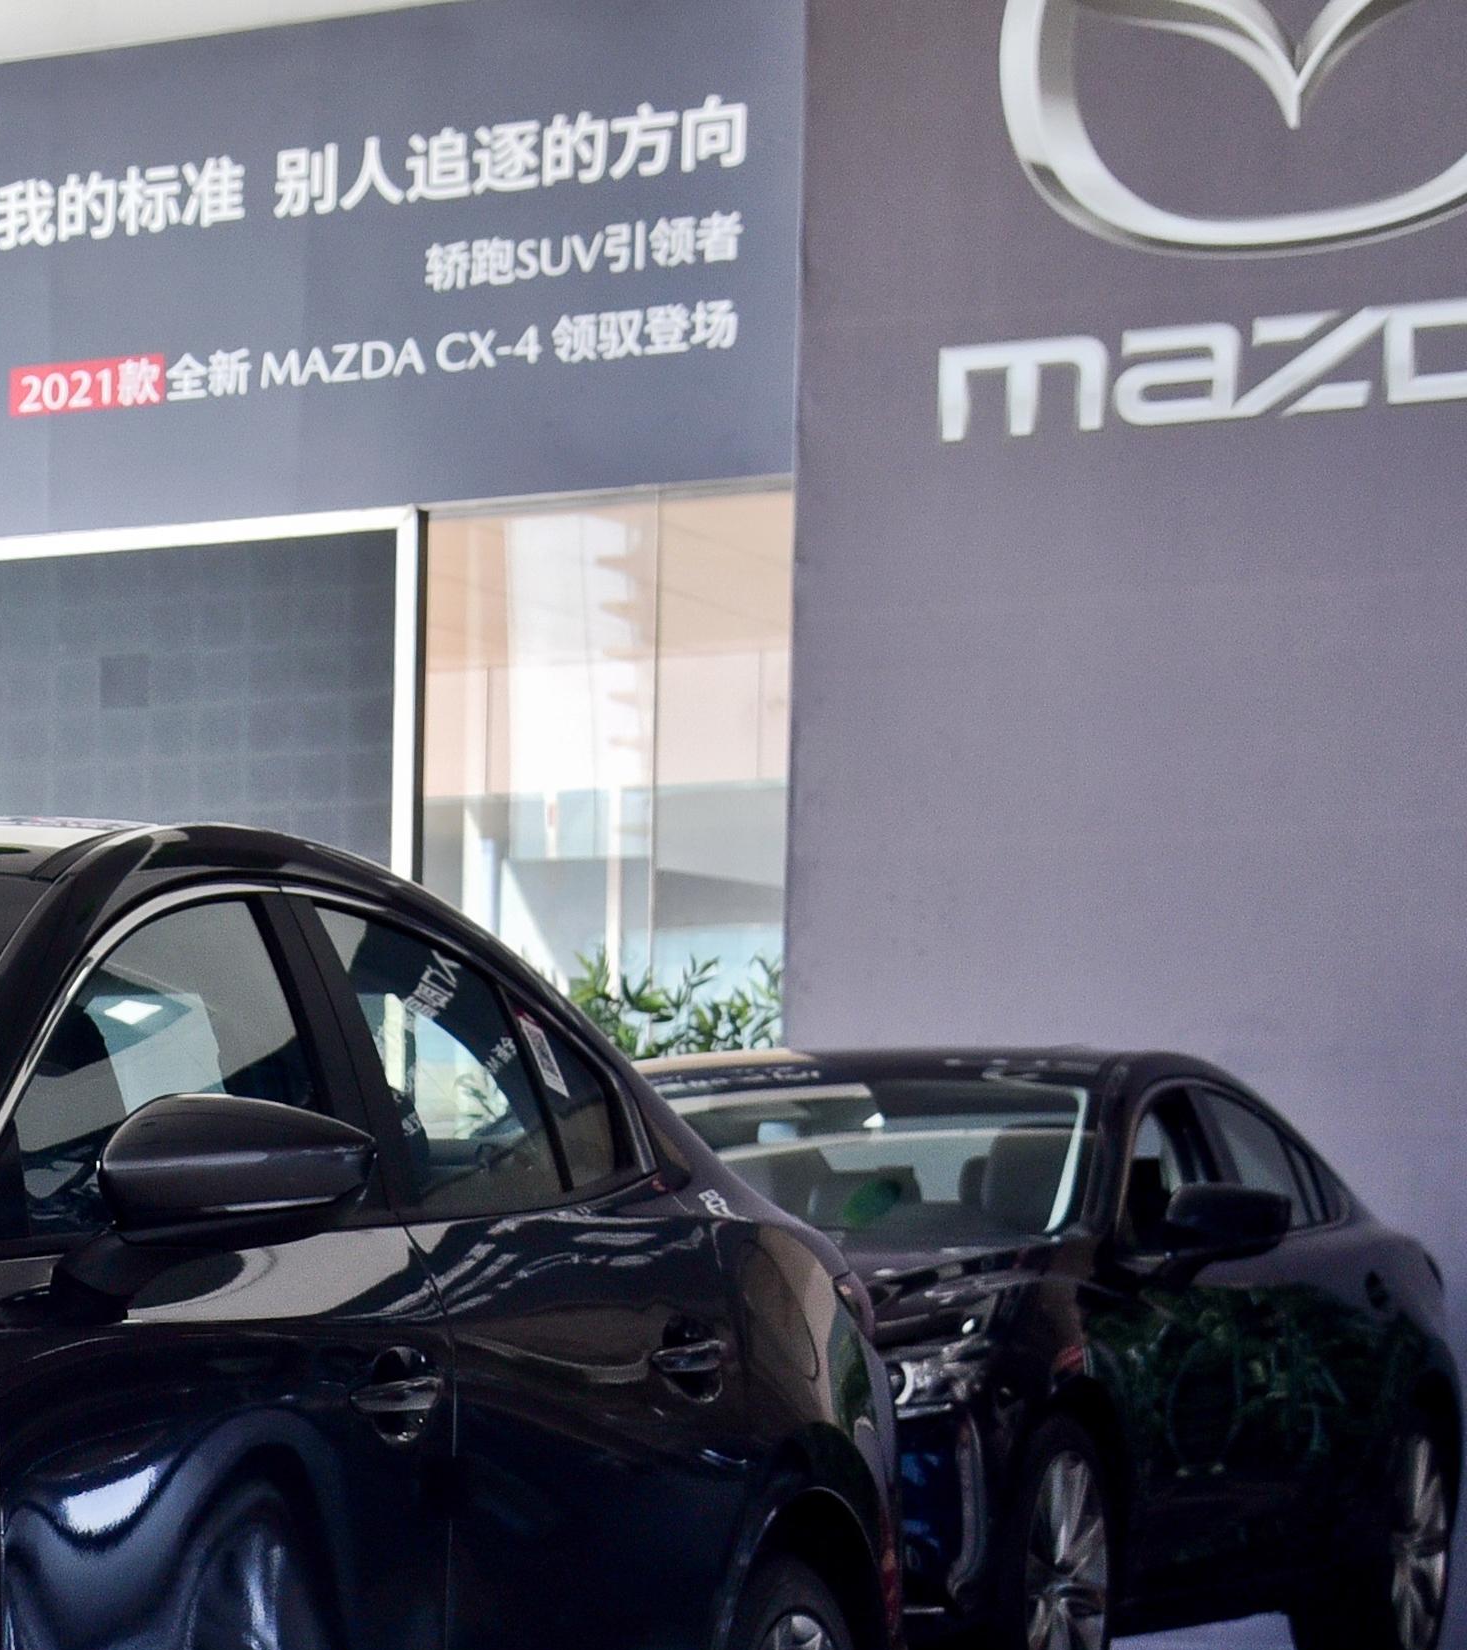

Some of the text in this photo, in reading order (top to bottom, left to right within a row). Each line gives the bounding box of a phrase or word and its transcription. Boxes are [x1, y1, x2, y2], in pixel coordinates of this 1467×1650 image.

[273, 94, 749, 220] 别人追逐的方向
[424, 211, 745, 292] 轿跑SUV引领者
[260, 335, 425, 391] MAZDA
[435, 325, 541, 374] CX-4
[551, 300, 738, 362] 领驭登场
